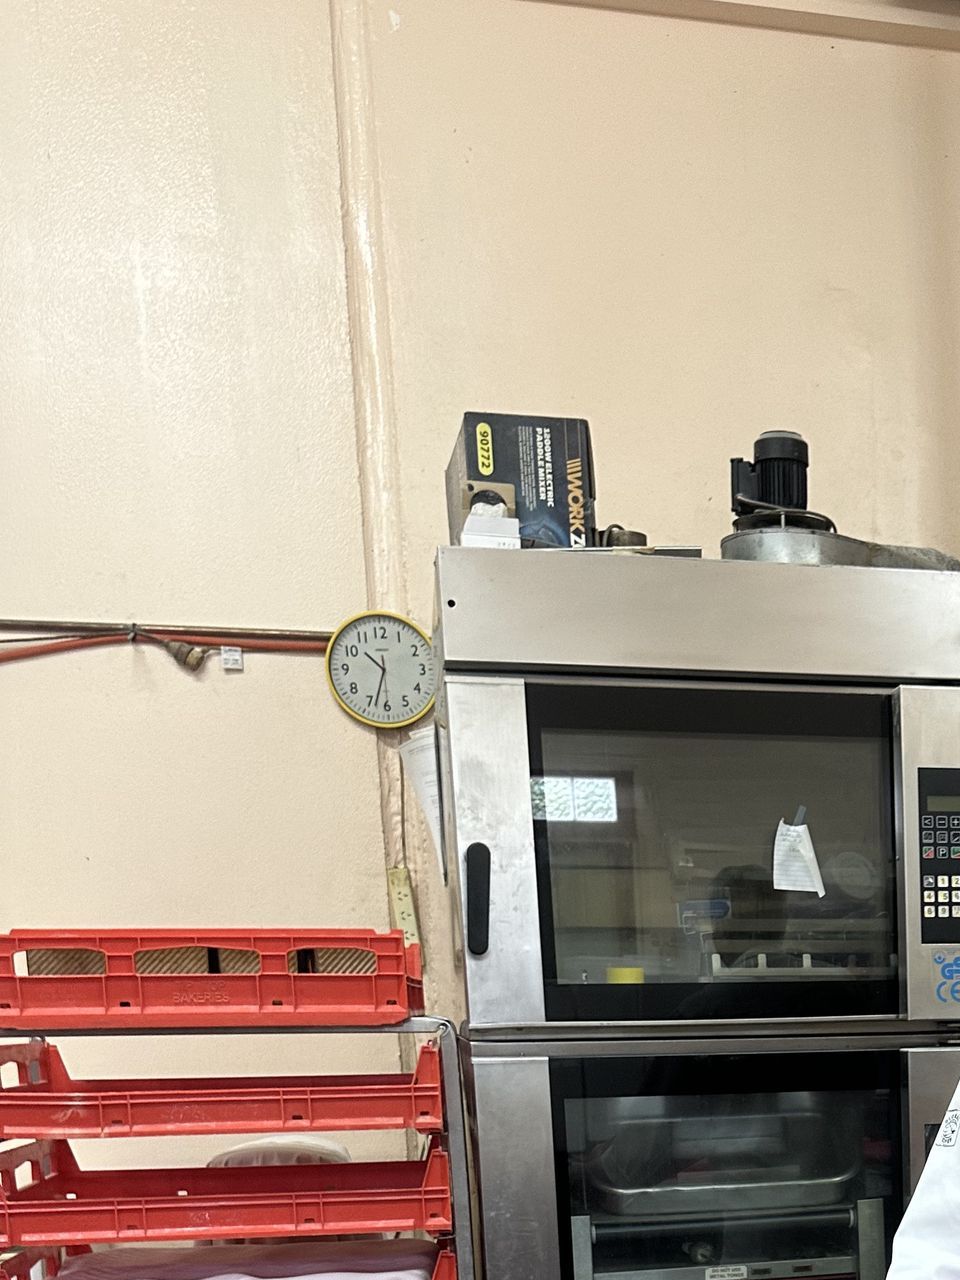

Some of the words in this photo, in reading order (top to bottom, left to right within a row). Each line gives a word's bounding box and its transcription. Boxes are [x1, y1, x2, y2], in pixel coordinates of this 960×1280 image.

[479, 430, 491, 469] 90772
[536, 427, 545, 467] PADDLE
[543, 427, 552, 462] 1200W
[538, 467, 547, 501] MIXER
[545, 462, 555, 508] ELECTRIC
[357, 631, 368, 644] 11
[373, 626, 388, 640] 12
[345, 644, 359, 658] 10
[411, 644, 419, 657] 2
[341, 663, 350, 676] 9
[419, 663, 426, 676] 3
[349, 682, 358, 695] 8
[413, 682, 421, 694] 4
[366, 695, 373, 707] 7
[383, 700, 392, 712] 6
[402, 695, 409, 707] 5
[173, 992, 231, 1003] BAKERIES
[936, 980, 960, 1003] CE
